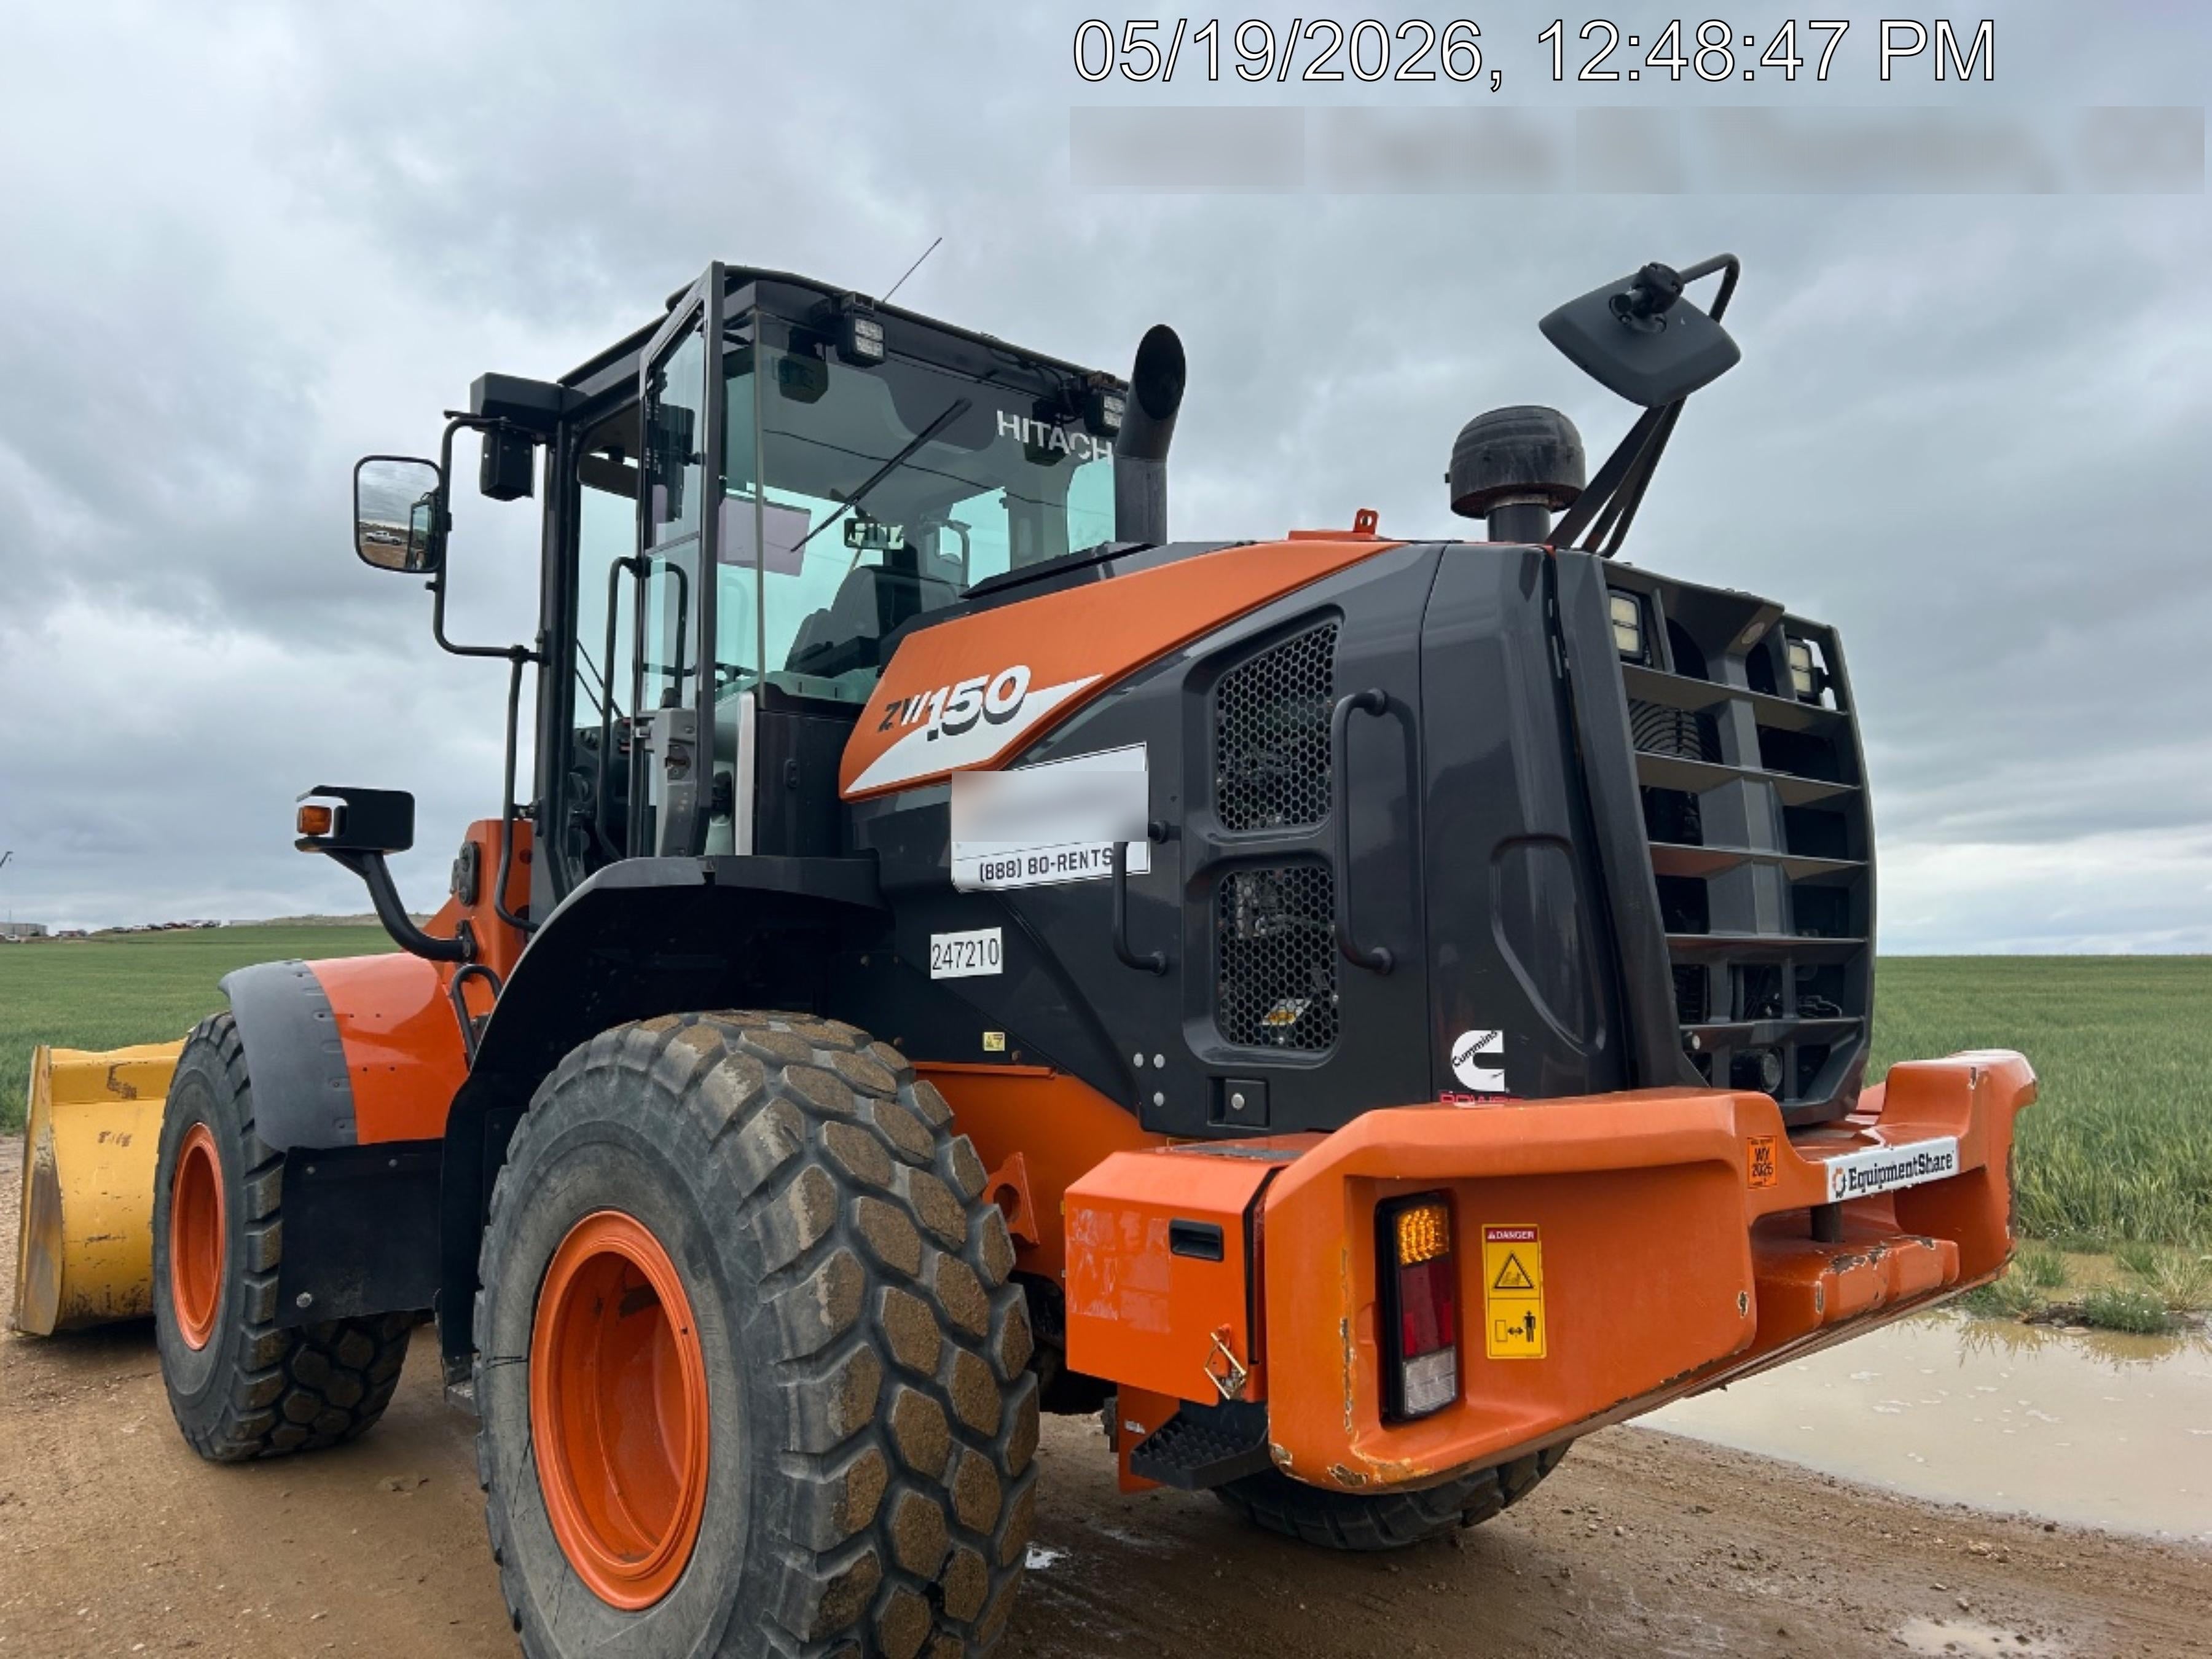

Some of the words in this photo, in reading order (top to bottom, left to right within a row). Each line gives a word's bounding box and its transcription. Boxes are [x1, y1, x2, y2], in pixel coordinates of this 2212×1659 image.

[997, 409, 1113, 466] HITACH
[979, 858, 1022, 882] (888)
[932, 938, 999, 970] 247210
[1452, 1030, 1498, 1067] Cummins
[1848, 1152, 1953, 1193] EquipmentShare
[1496, 1230, 1534, 1240] DANGER
